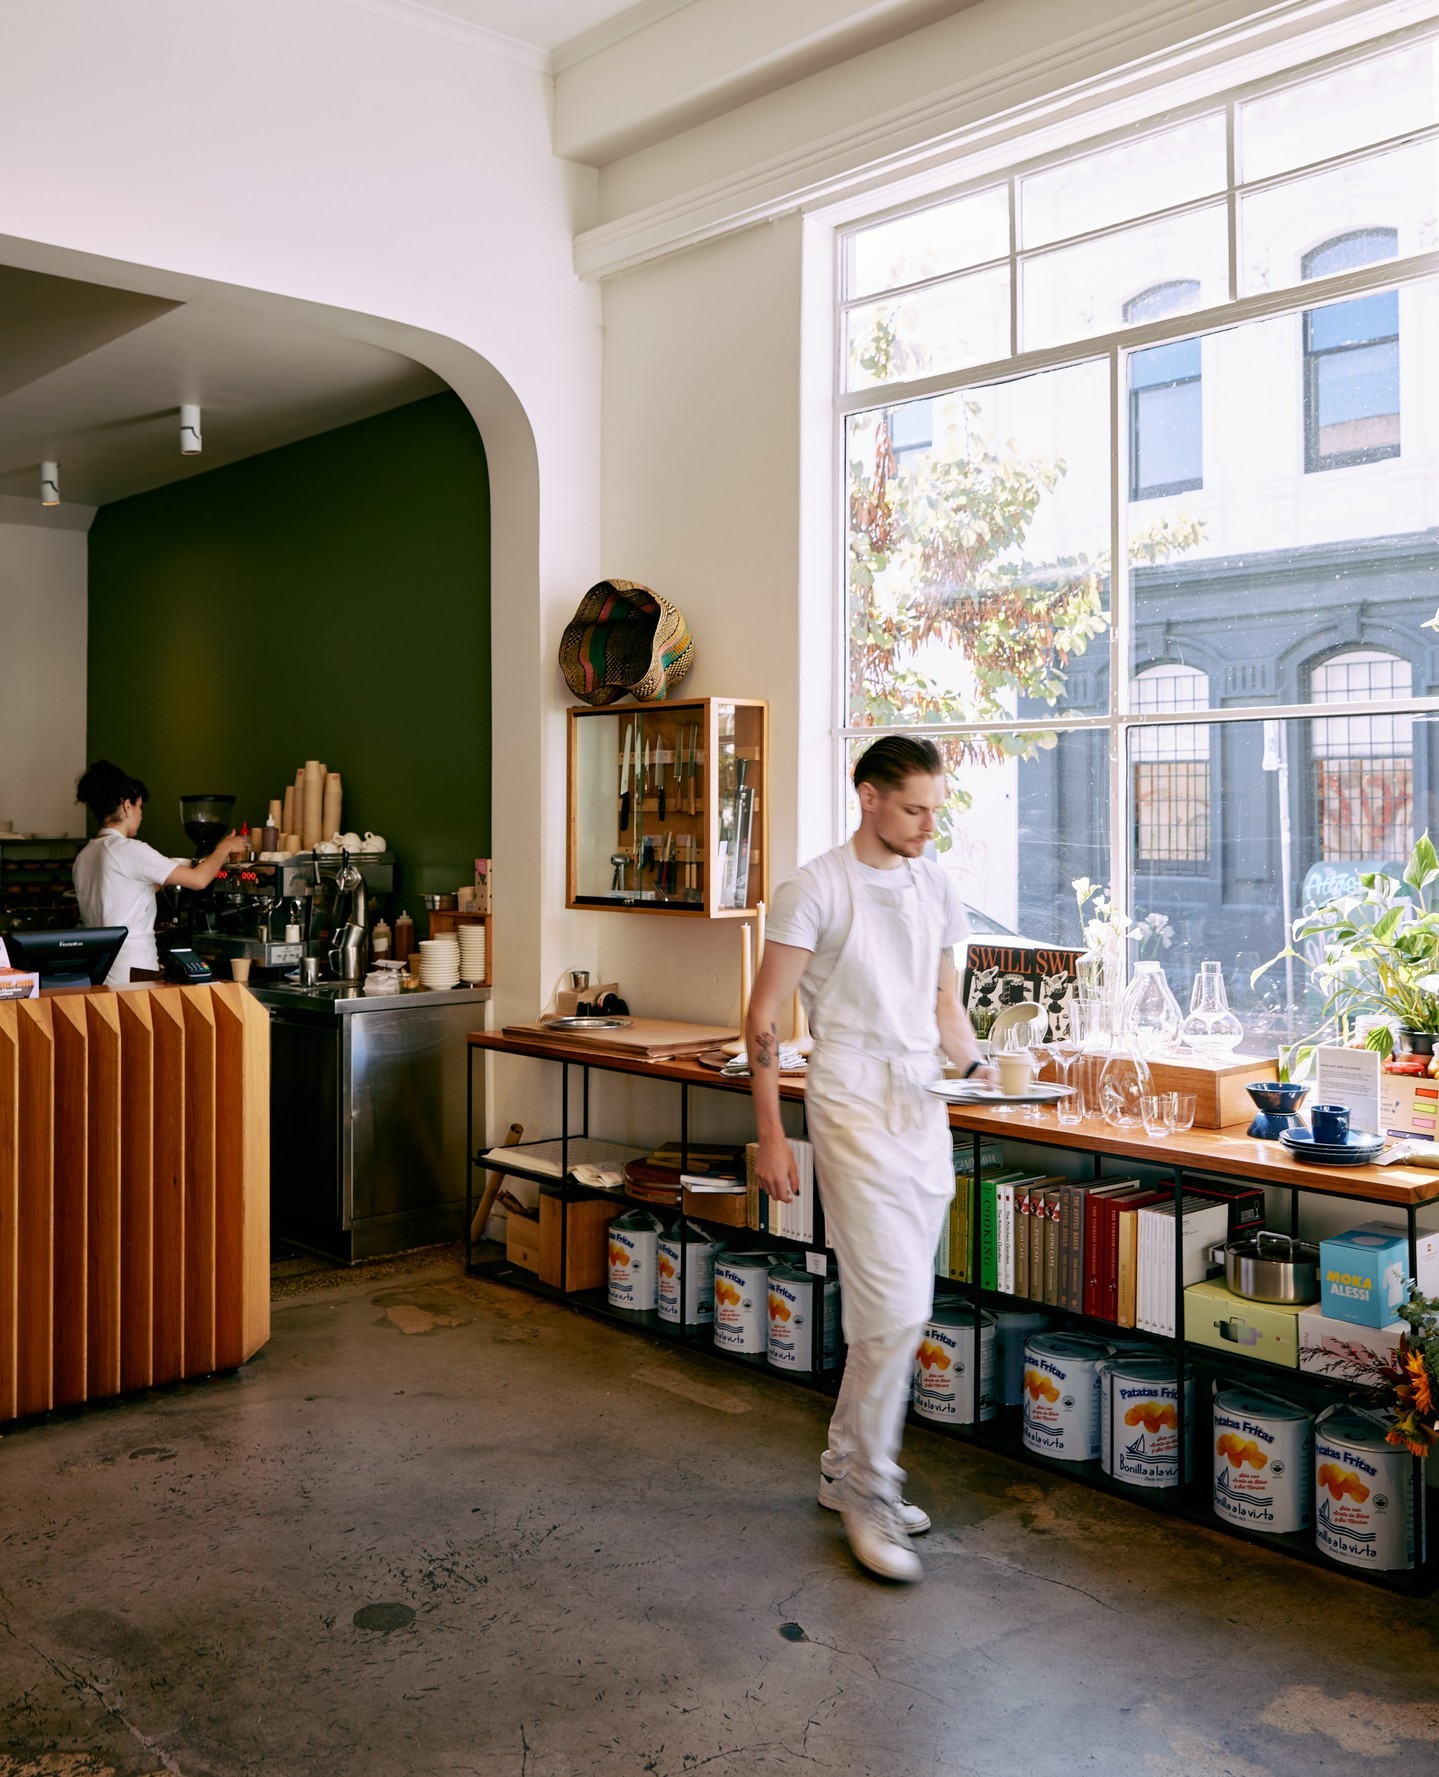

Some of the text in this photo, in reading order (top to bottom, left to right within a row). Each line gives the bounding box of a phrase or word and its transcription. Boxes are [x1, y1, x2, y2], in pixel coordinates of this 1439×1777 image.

[968, 946, 1032, 974] SWILL
[616, 1234, 634, 1249] Fritas
[984, 1200, 992, 1266] COOKING
[662, 1244, 679, 1260] Fritas
[725, 1270, 746, 1286] Fritas
[1327, 1270, 1372, 1290] MOKA
[776, 1285, 796, 1302] Fritas
[1330, 1283, 1370, 1302] ALESSI
[931, 1329, 957, 1348] Fritas
[1040, 1360, 1066, 1380] Fritas
[1120, 1387, 1159, 1400] Patatas
[1243, 1422, 1275, 1443] Fritas
[1043, 1437, 1064, 1449] vista
[1120, 1453, 1148, 1475] Bonilla
[1156, 1465, 1164, 1477] la
[1343, 1452, 1377, 1476] Fritas
[1238, 1503, 1246, 1516] la
[1248, 1508, 1274, 1521] vista
[1339, 1537, 1347, 1551] la
[1349, 1544, 1377, 1557] vista
